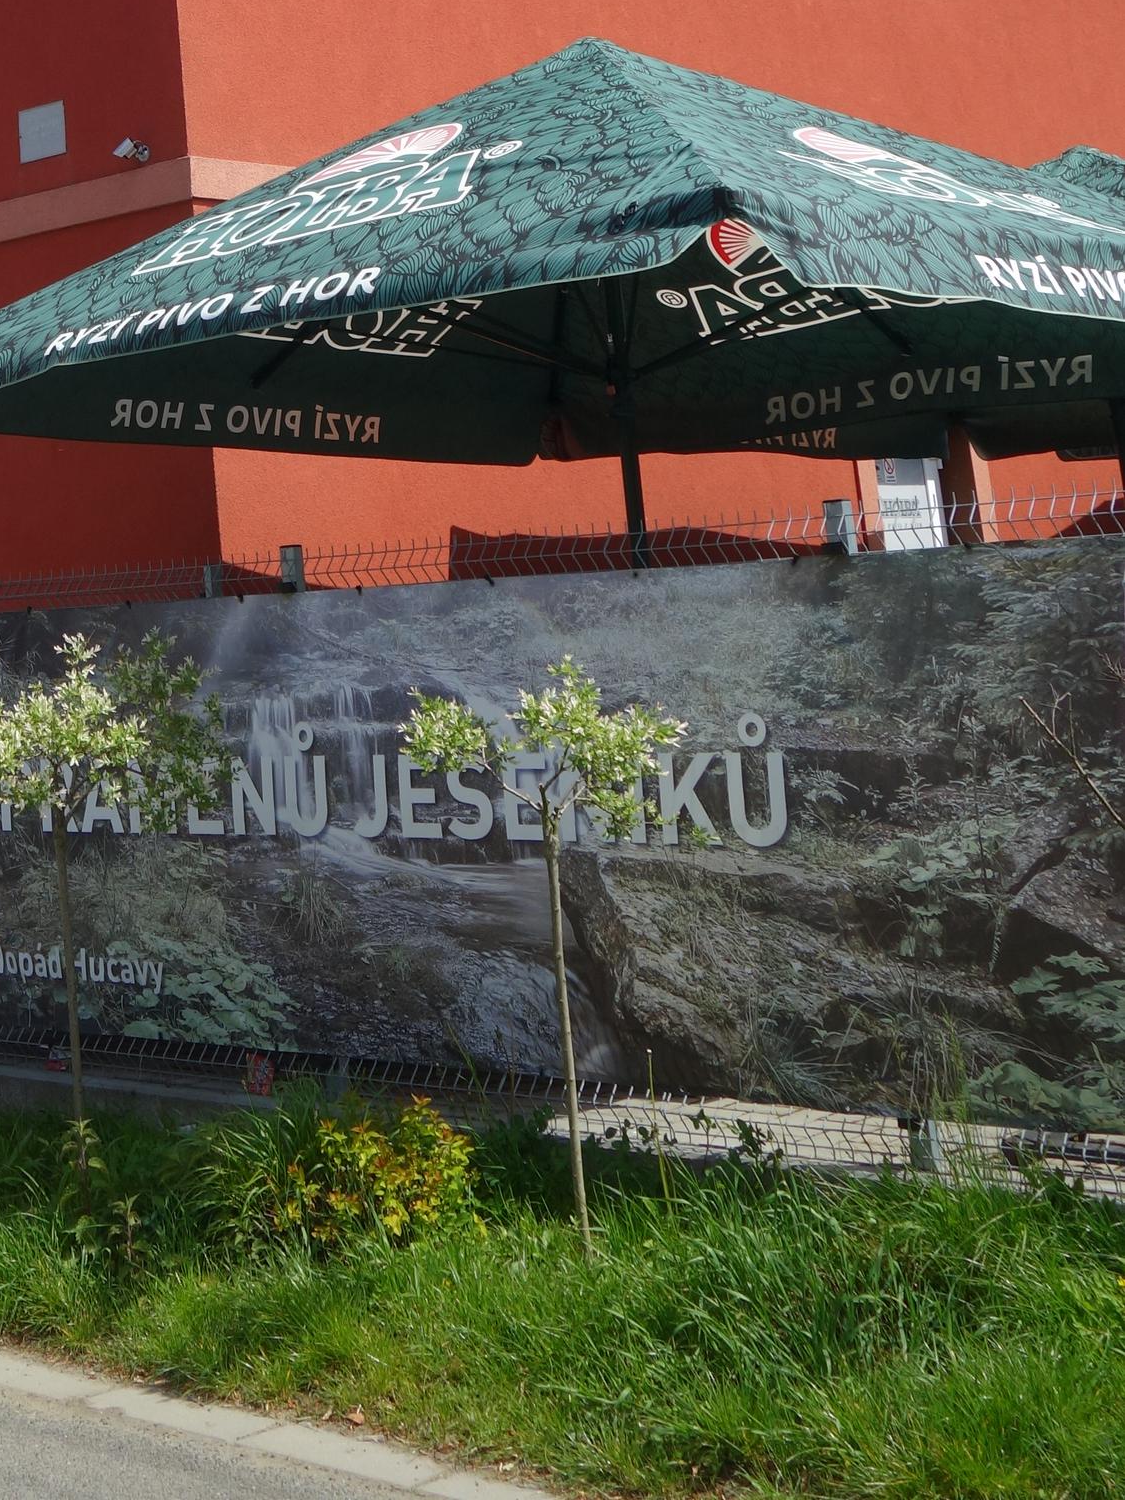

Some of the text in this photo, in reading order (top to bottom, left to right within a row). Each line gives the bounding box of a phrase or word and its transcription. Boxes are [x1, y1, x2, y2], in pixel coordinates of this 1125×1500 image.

[975, 254, 1065, 296] RYZÍ
[43, 311, 143, 356] RYZÍ
[137, 292, 234, 335] PIVO
[240, 286, 274, 315] Z
[279, 267, 382, 307] HOR
